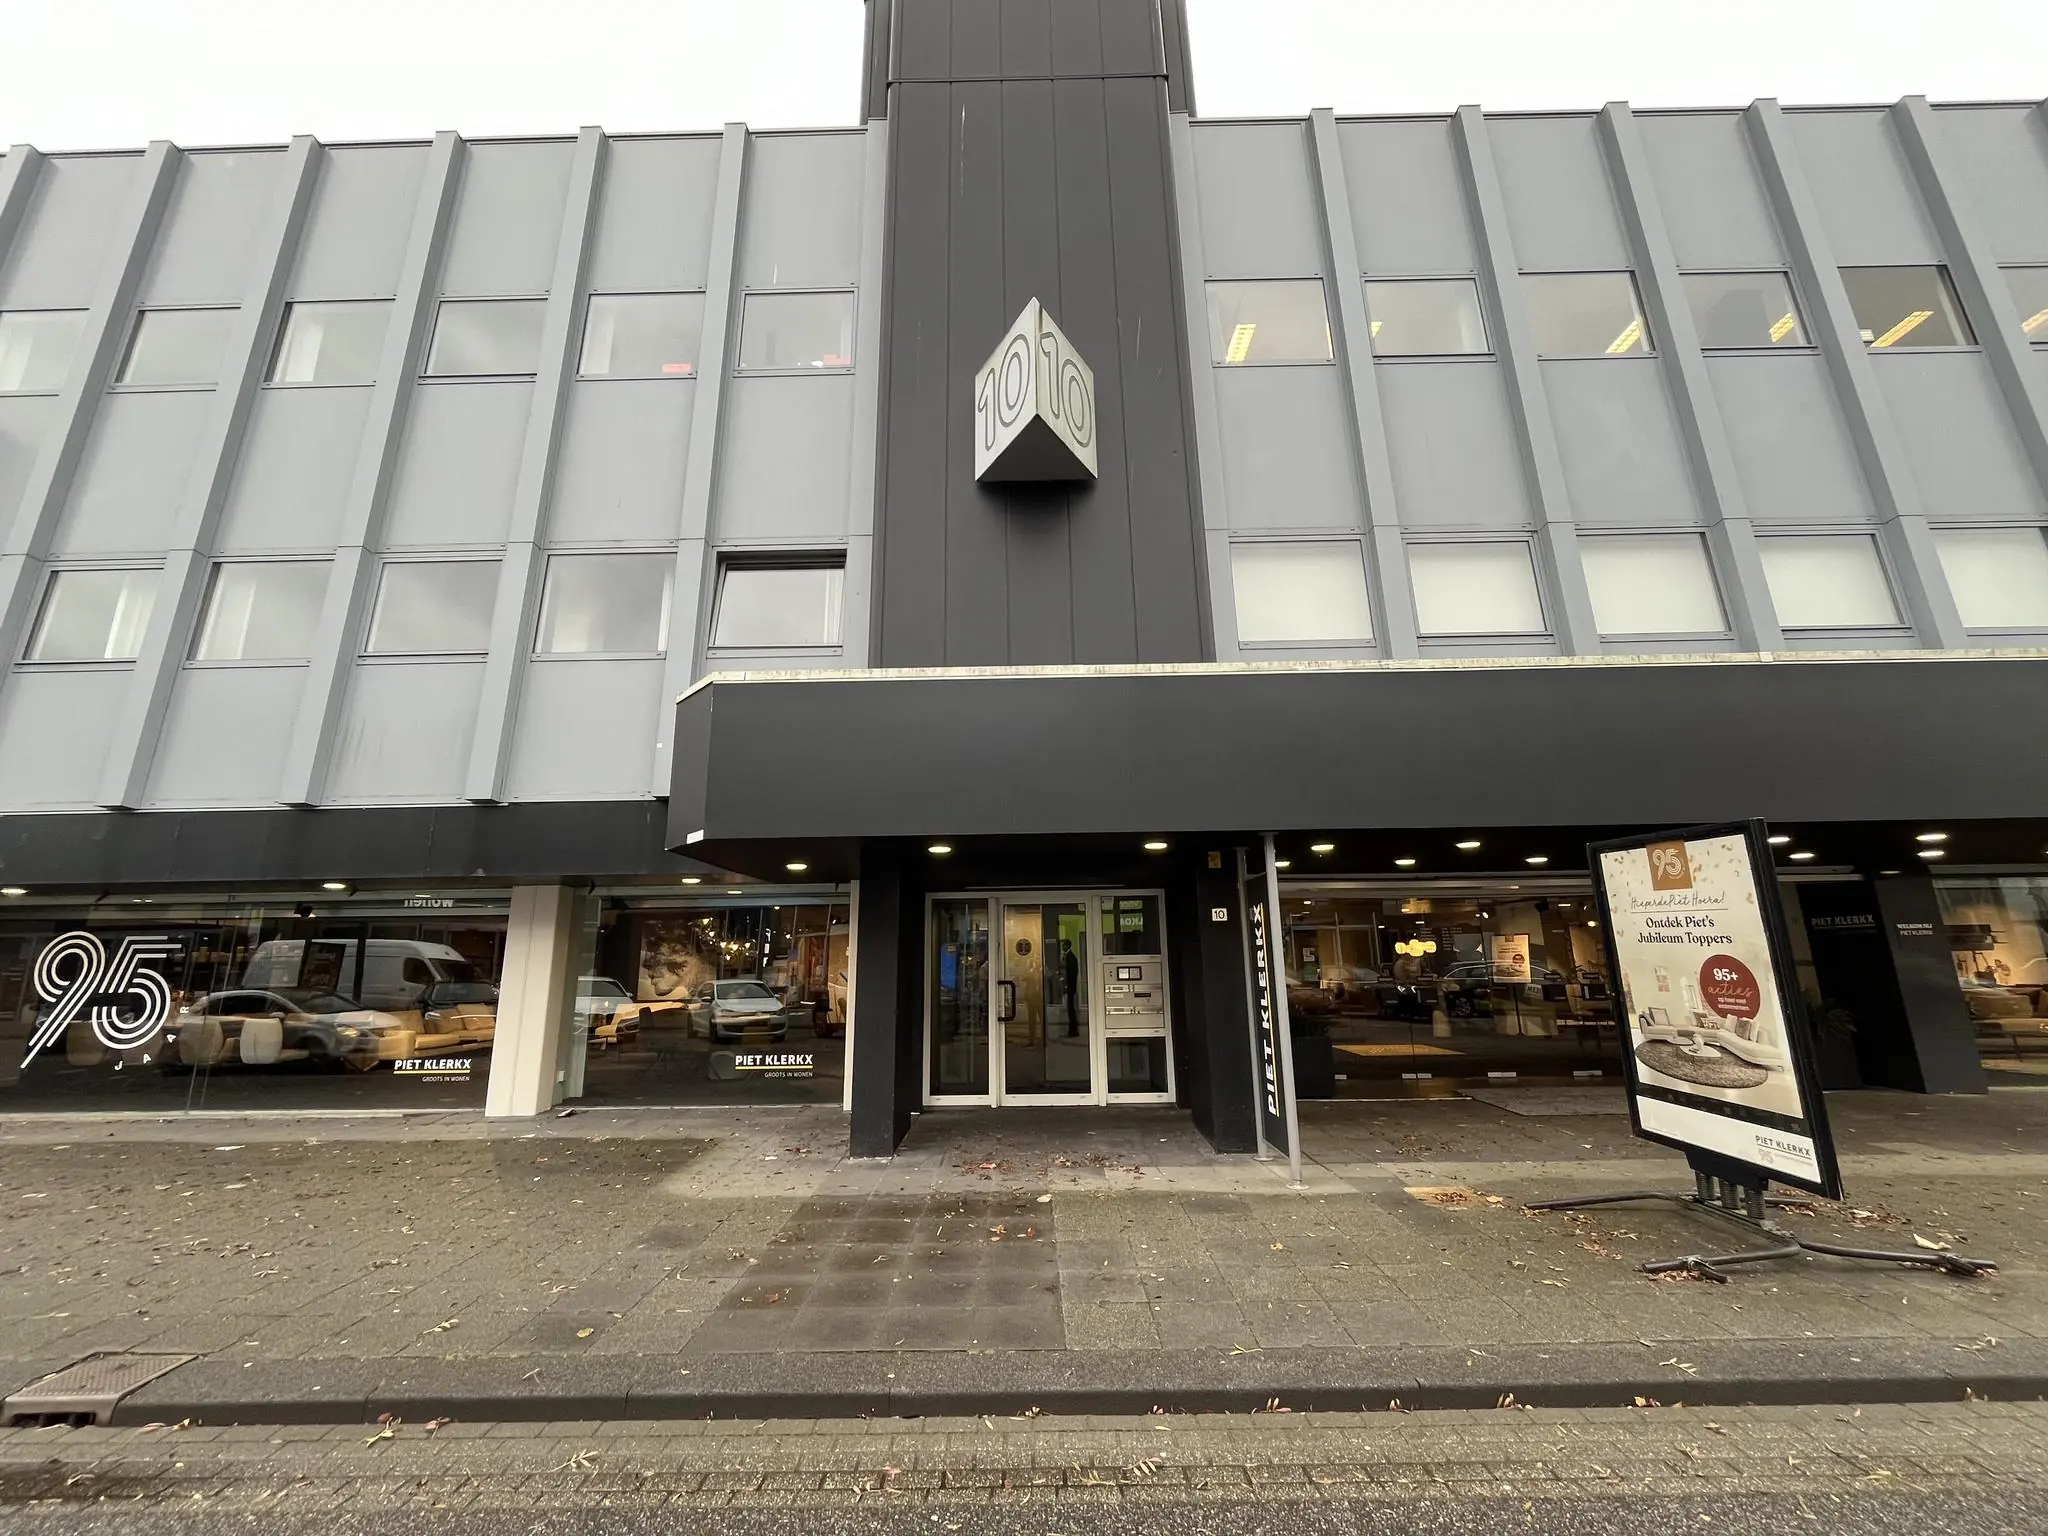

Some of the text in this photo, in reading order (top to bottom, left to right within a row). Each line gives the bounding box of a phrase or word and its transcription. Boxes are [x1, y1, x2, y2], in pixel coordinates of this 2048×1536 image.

[978, 333, 1031, 452] 10
[1039, 331, 1092, 448] 10
[1652, 848, 1682, 881] 95
[1691, 890, 1726, 908] Hoera!
[1213, 909, 1226, 919] 10
[1645, 914, 1715, 929] Ontdek Piet's
[1811, 913, 1875, 927] PIET KLERKX
[1637, 931, 1733, 947] Jubileum Toppers
[1713, 968, 1739, 982] 95+
[20, 930, 182, 1069] 95
[1251, 904, 1277, 1117] PIET KLERKX
[394, 1058, 472, 1070] PIET KLERKX
[735, 1054, 814, 1066] PIET KLERKX
[1755, 1135, 1811, 1157] PIET KLERKX
